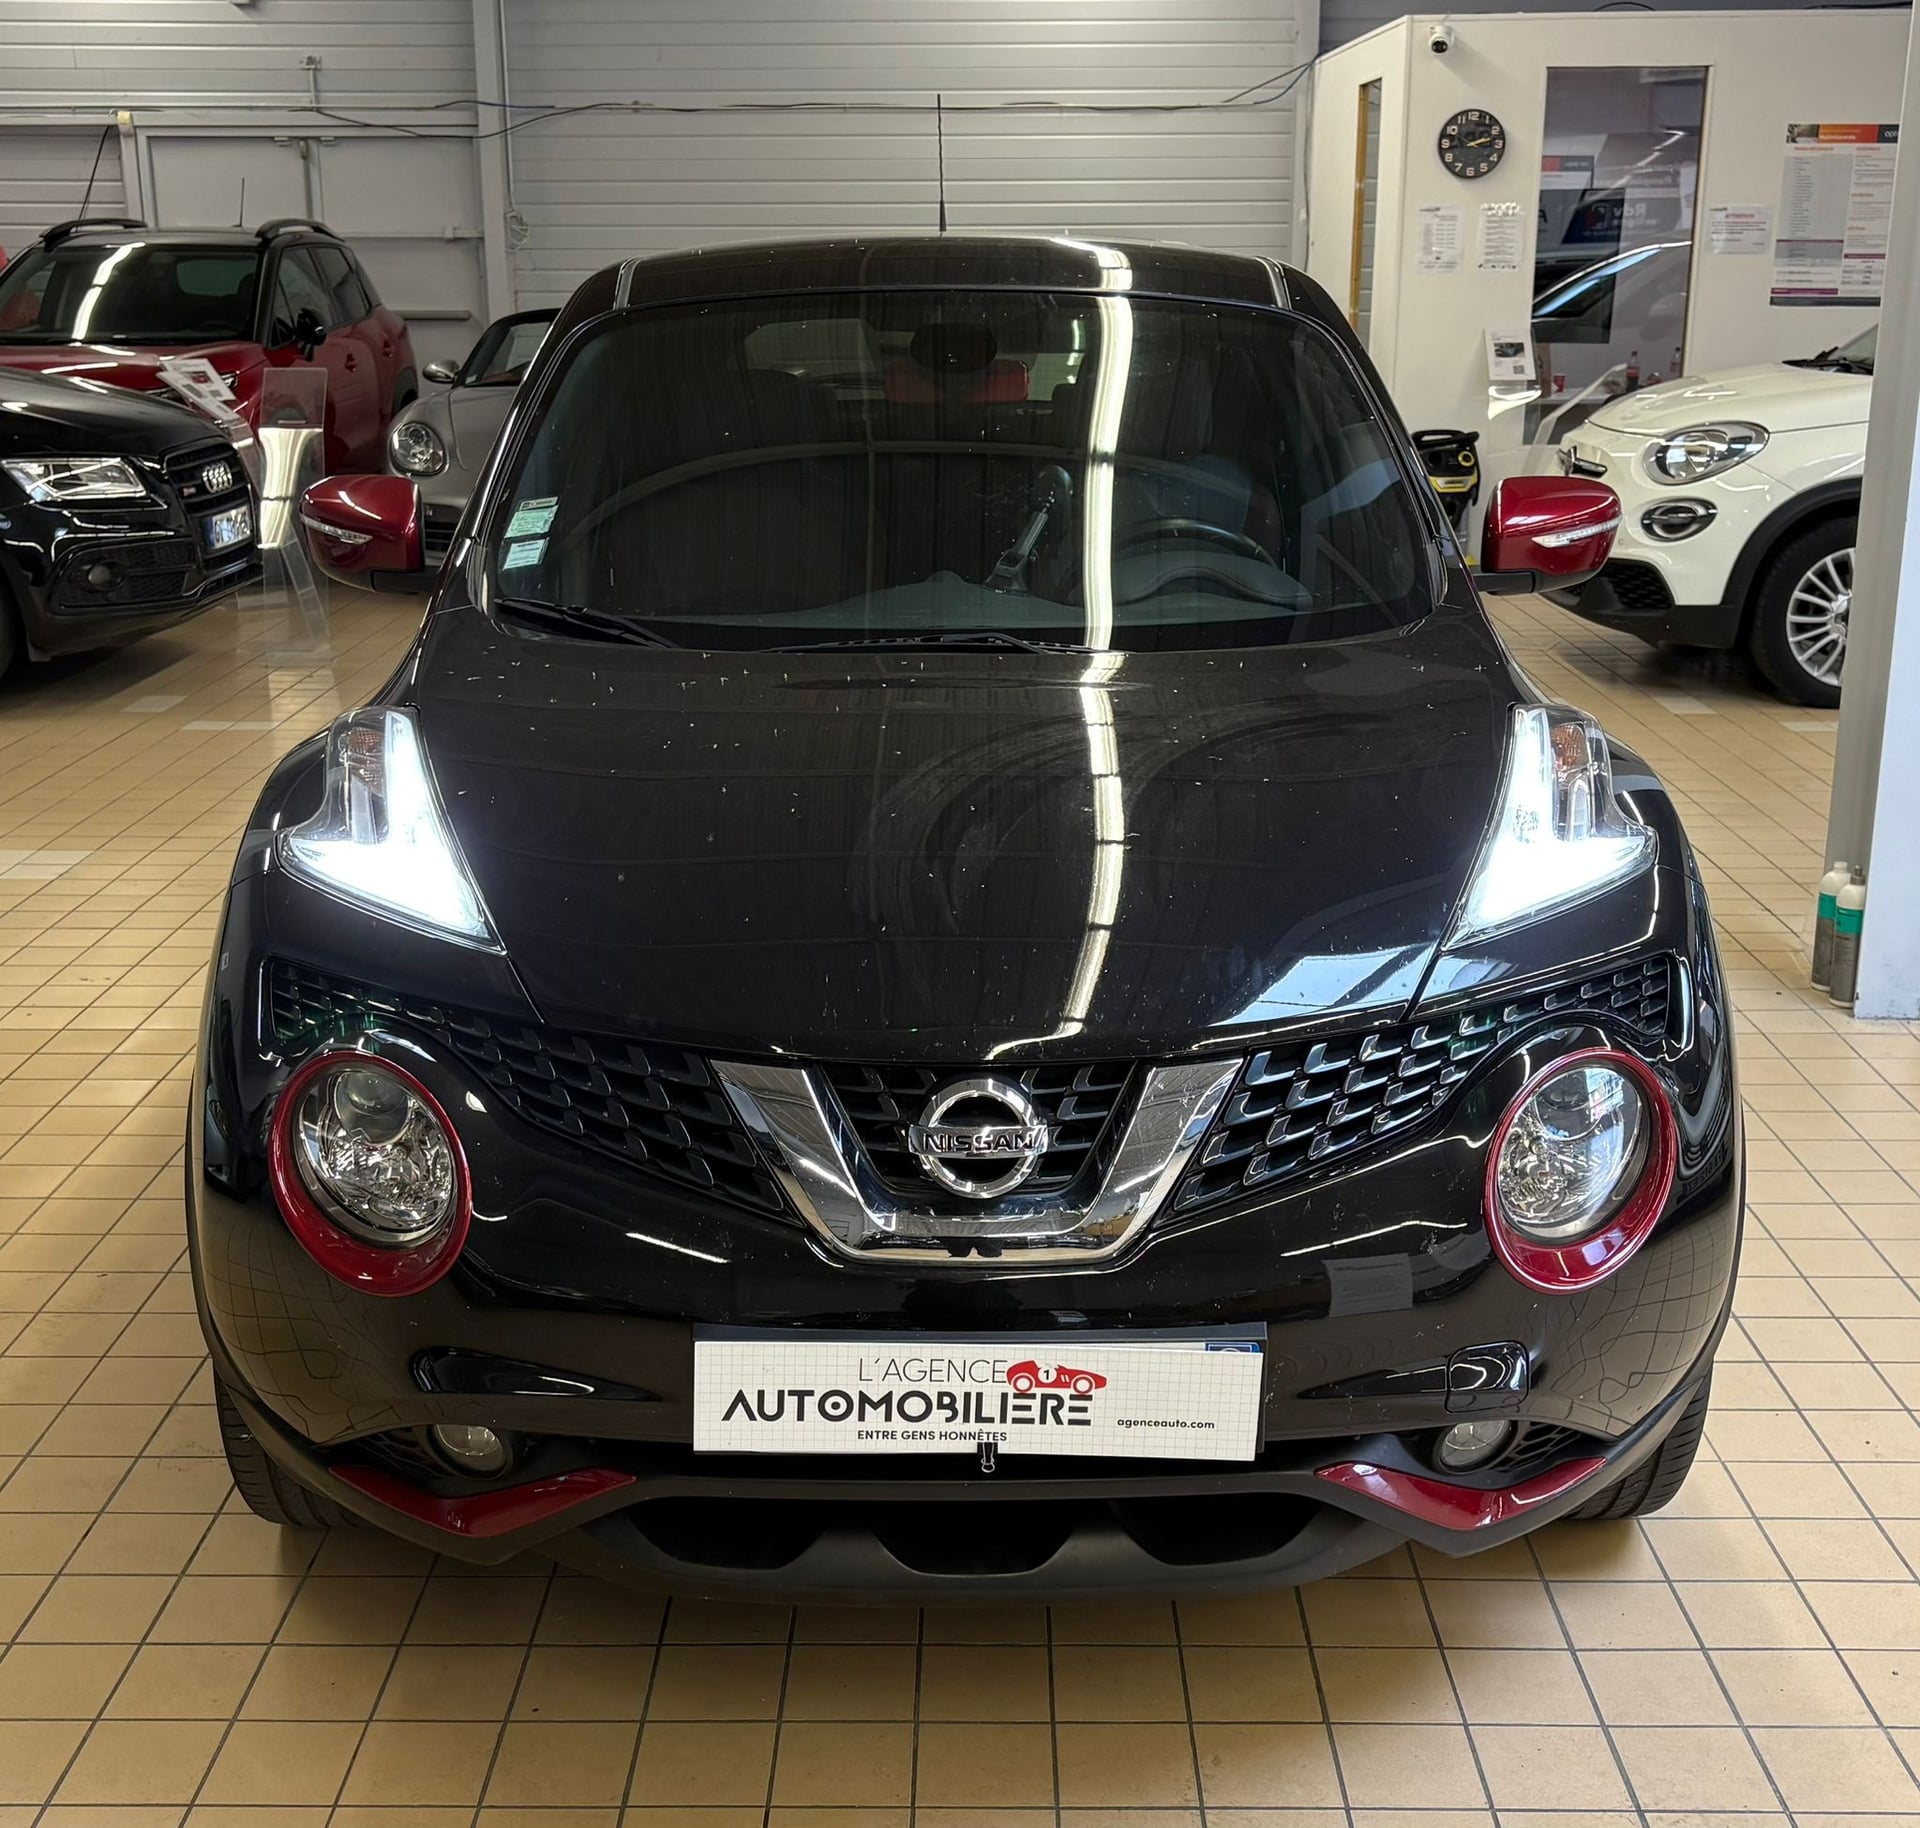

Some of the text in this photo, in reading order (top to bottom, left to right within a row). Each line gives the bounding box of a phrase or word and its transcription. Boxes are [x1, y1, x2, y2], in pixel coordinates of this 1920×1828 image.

[1457, 115, 1466, 124] 11
[1468, 111, 1480, 121] 12
[1486, 116, 1490, 124] 1
[1446, 125, 1458, 135] 10
[1491, 126, 1500, 135] 2
[1441, 139, 1450, 149] 9
[1494, 140, 1504, 149] 3
[1444, 153, 1453, 162] 8
[1489, 153, 1498, 162] 4
[1454, 162, 1463, 172] 7
[1466, 167, 1475, 176] 6
[1479, 162, 1489, 172] 5
[923, 1132, 1035, 1153] NISSAN
[859, 1358, 1008, 1383] L'AGENCE
[1117, 1417, 1215, 1430] agenceauto.com
[857, 1428, 1008, 1442] ENTRE GENS HONNÊTES
